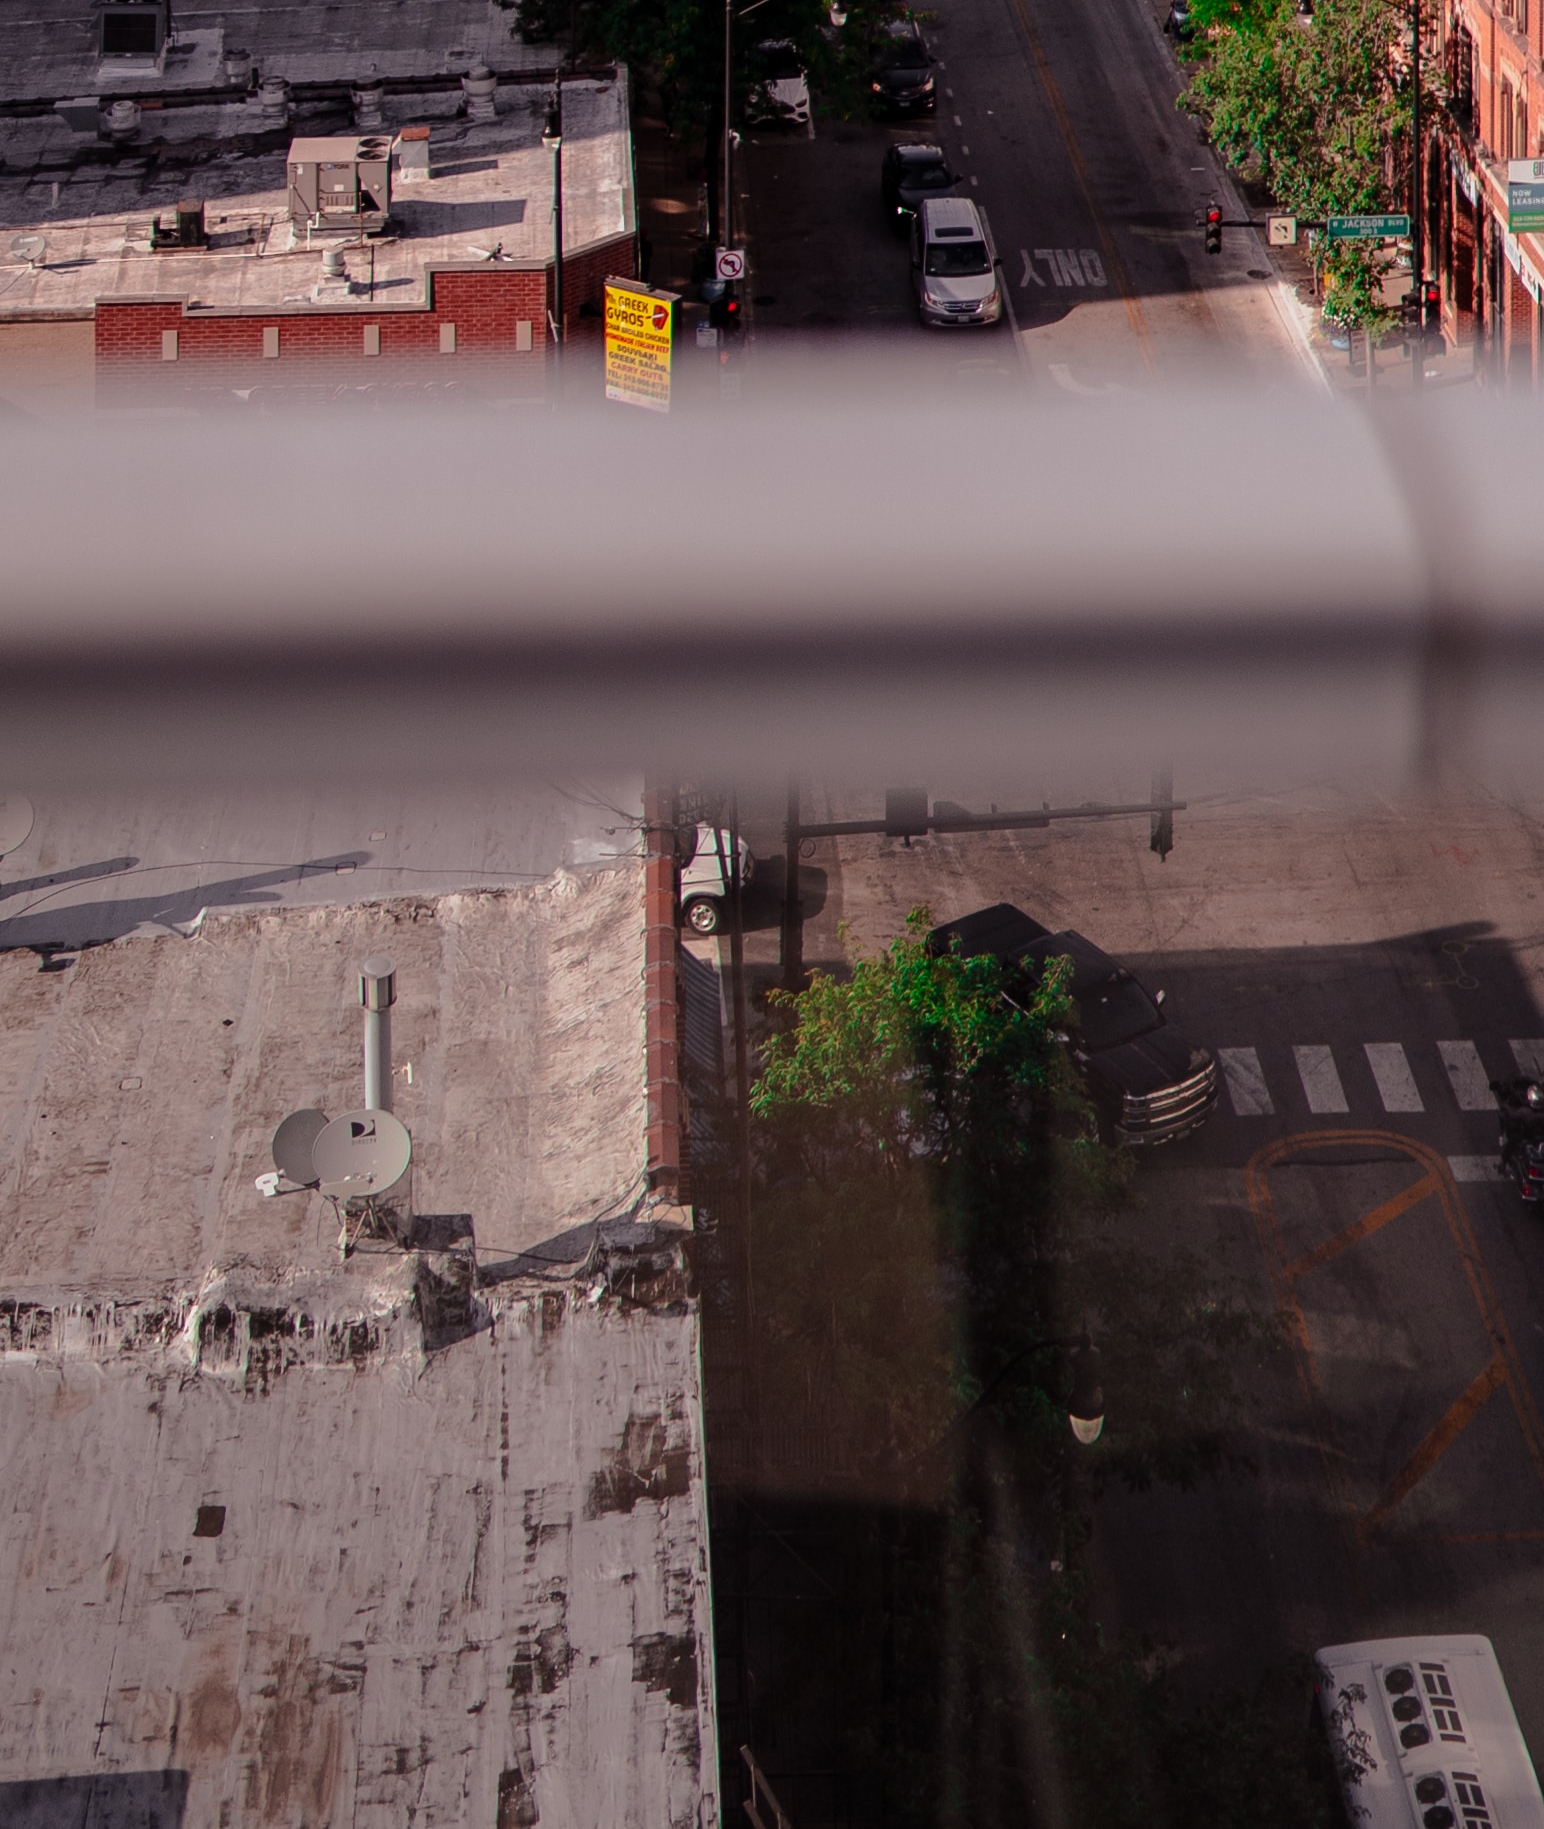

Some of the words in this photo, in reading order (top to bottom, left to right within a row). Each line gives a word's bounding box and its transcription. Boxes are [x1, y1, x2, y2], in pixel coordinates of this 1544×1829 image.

[1512, 189, 1532, 197] NOW
[1342, 219, 1385, 229] JACKSON
[1387, 219, 1405, 227] BLVD
[1020, 249, 1108, 287] ONLY
[618, 295, 649, 314] GREEK
[606, 306, 645, 328] GYROS
[608, 351, 636, 365] GREEK
[617, 344, 658, 361] SOUVLAKI
[611, 361, 638, 374] CARRY
[640, 369, 663, 381] OUTS
